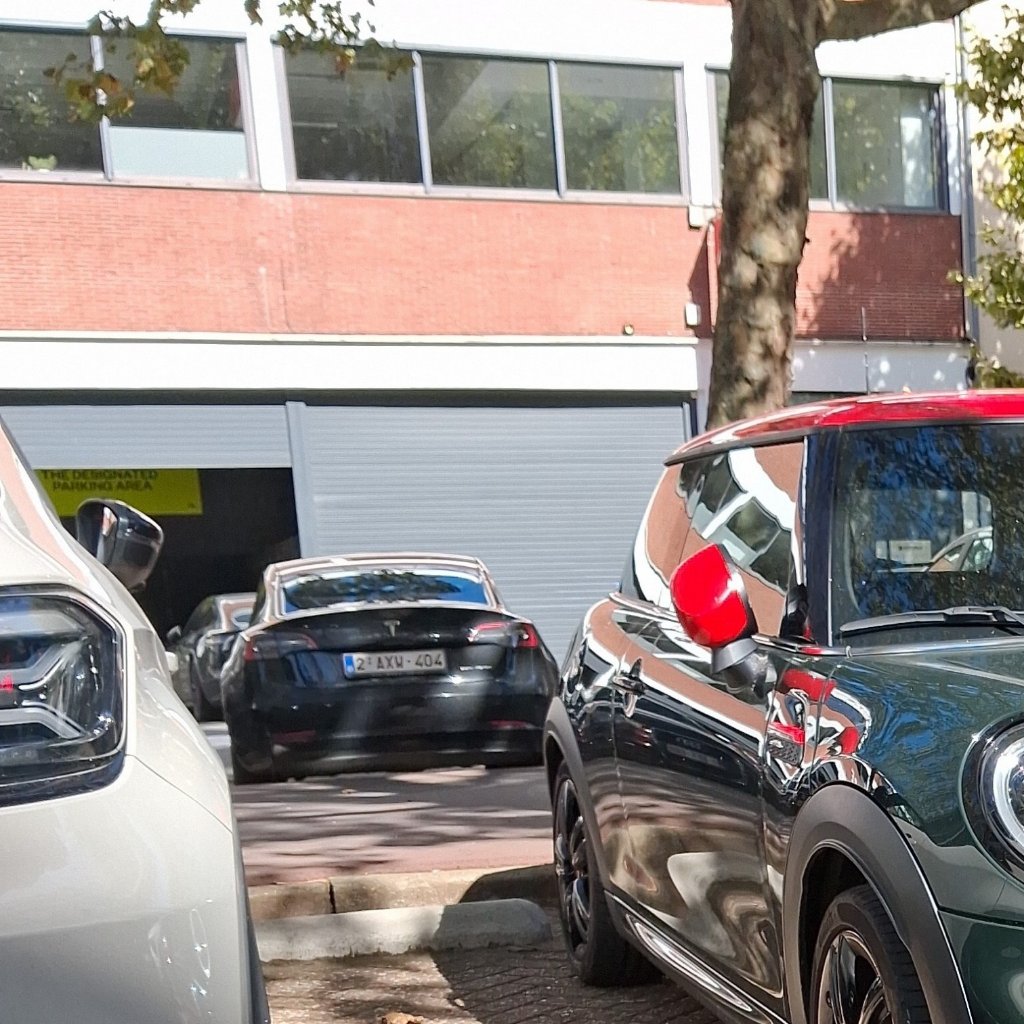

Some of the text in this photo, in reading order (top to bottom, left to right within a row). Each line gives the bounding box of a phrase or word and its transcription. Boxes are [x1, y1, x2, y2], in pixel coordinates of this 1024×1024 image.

[41, 469, 159, 480] THE DESIGNATED
[53, 480, 153, 491] PARKING AREA
